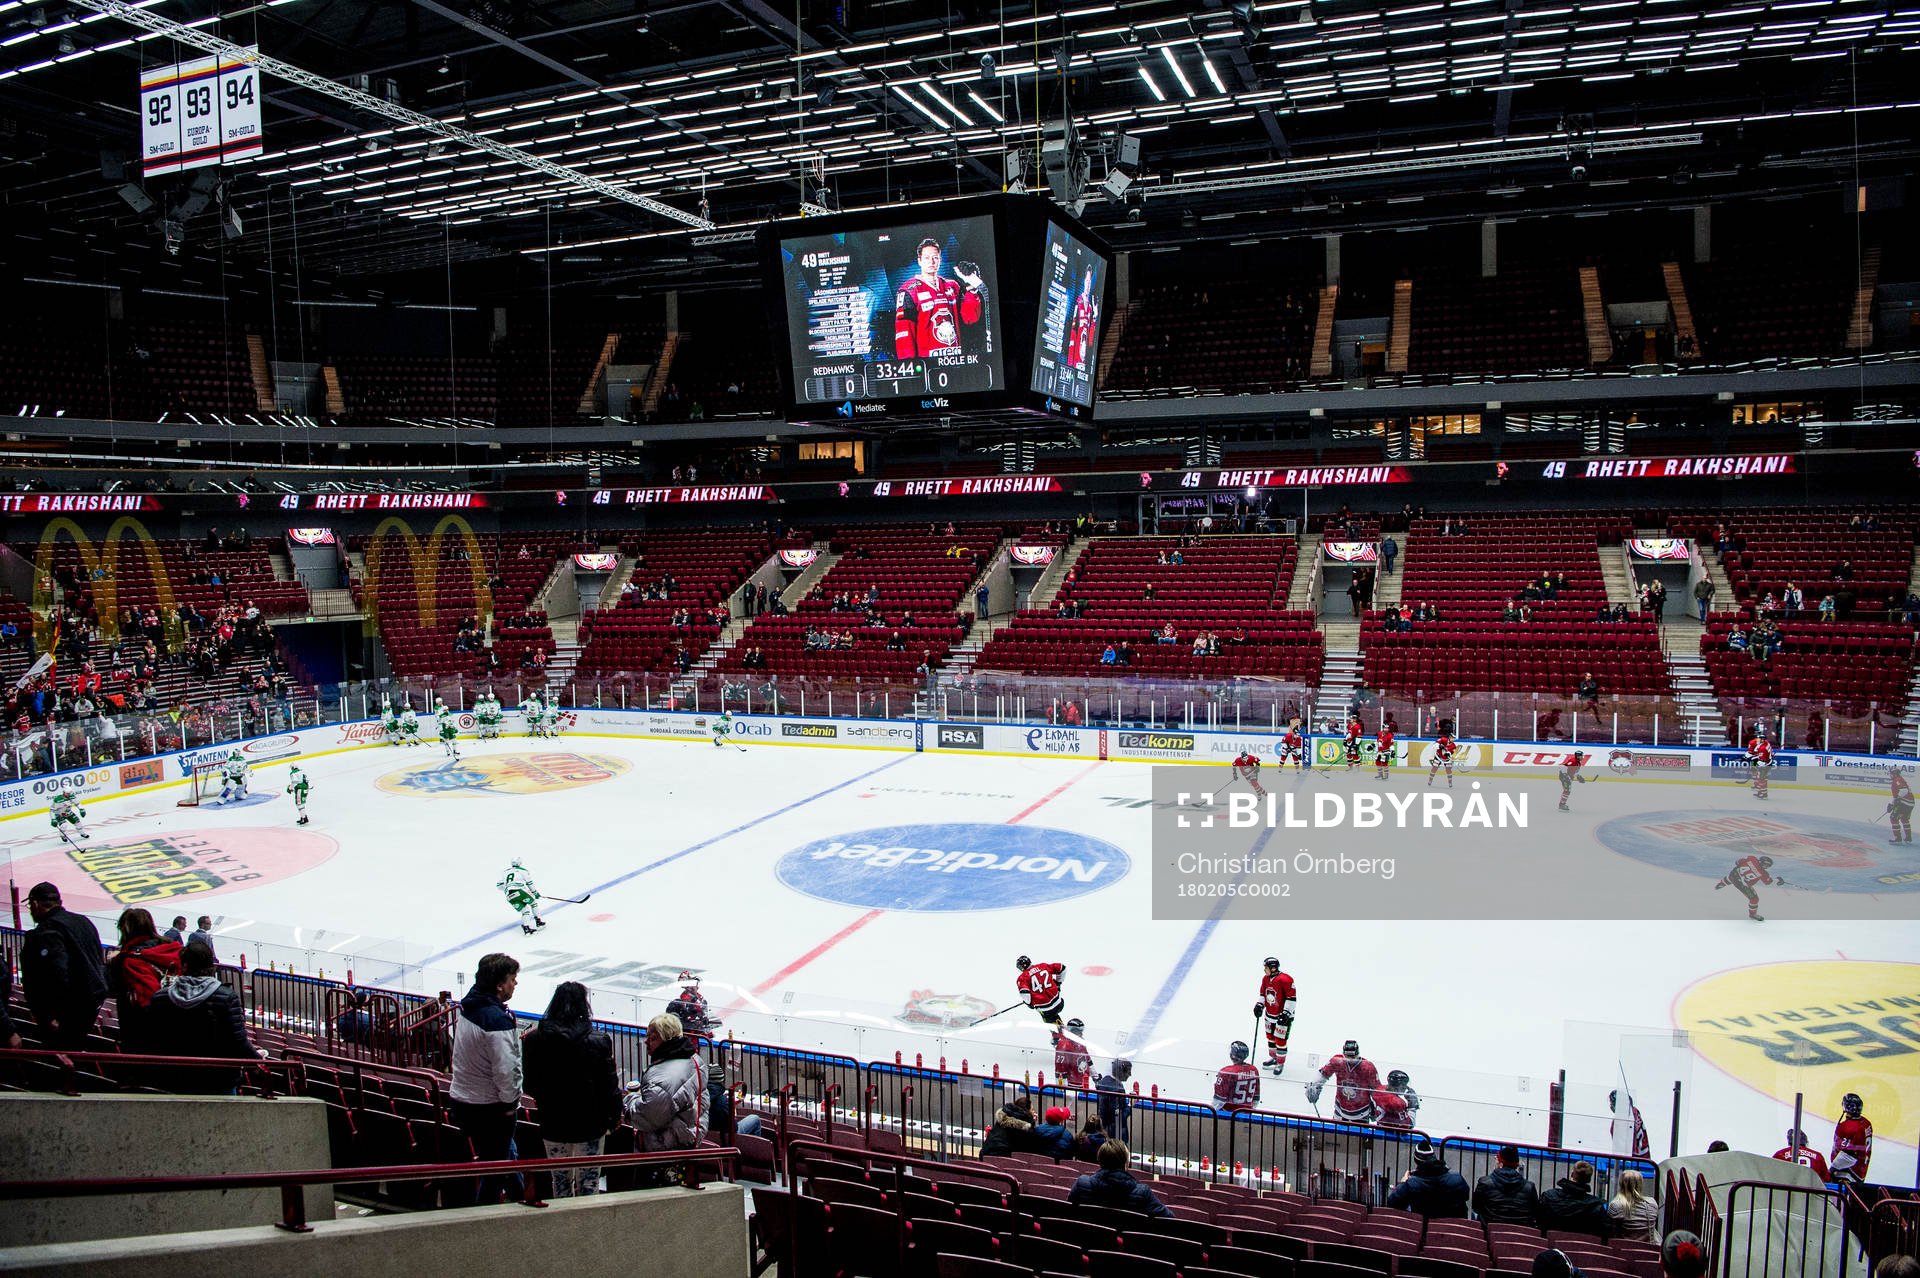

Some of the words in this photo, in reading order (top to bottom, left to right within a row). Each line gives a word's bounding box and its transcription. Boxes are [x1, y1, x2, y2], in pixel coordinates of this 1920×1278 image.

[226, 75, 254, 109] 94
[187, 86, 210, 118] 93
[149, 94, 172, 126] 92
[187, 126, 212, 137] EUROPA-
[228, 124, 255, 138] SM-GULD
[149, 141, 174, 155] SM-GULD
[192, 136, 207, 146] GULD
[801, 253, 817, 268] 49
[938, 356, 965, 366] RÖGLE
[967, 355, 979, 364] BK
[813, 365, 855, 376] REDHAWKS
[876, 362, 914, 379] 33:44
[846, 380, 855, 393] 0
[939, 373, 948, 387] 0
[892, 381, 899, 394] 1
[855, 404, 886, 412] Mediatec
[921, 398, 949, 409] tecViz
[1543, 462, 1566, 478] 49
[1586, 460, 1651, 477] RHETT
[1664, 456, 1787, 475] RAKHSHANI
[1181, 472, 1201, 488] 49
[1218, 470, 1274, 486] RHETT
[1285, 467, 1391, 485] RAKHSHANI
[874, 482, 891, 496] 49
[905, 480, 952, 495] RHETT
[962, 477, 1050, 493] RAKHSHANI
[280, 495, 299, 509] 49
[316, 495, 368, 508] RHETT
[379, 494, 472, 508] RAKHSHANI
[593, 491, 611, 504] 49
[626, 489, 671, 503] RHETT
[681, 486, 764, 501] RAKHSHANI
[37, 495, 142, 511] RAKHSHANI
[735, 721, 772, 736] Ocab
[783, 725, 835, 737] Tedadmin
[847, 726, 912, 740] sandberg
[1045, 729, 1080, 741] EKDAHL
[941, 730, 977, 744] RSA
[1120, 733, 1194, 749] Tedkomp
[1045, 741, 1065, 753] MILJÖ
[1068, 743, 1080, 753] AB
[1211, 741, 1273, 755] ALLIANCE
[1900, 764, 1916, 773] AB
[809, 842, 1111, 883] NordicBet
[1031, 970, 1052, 993] 42
